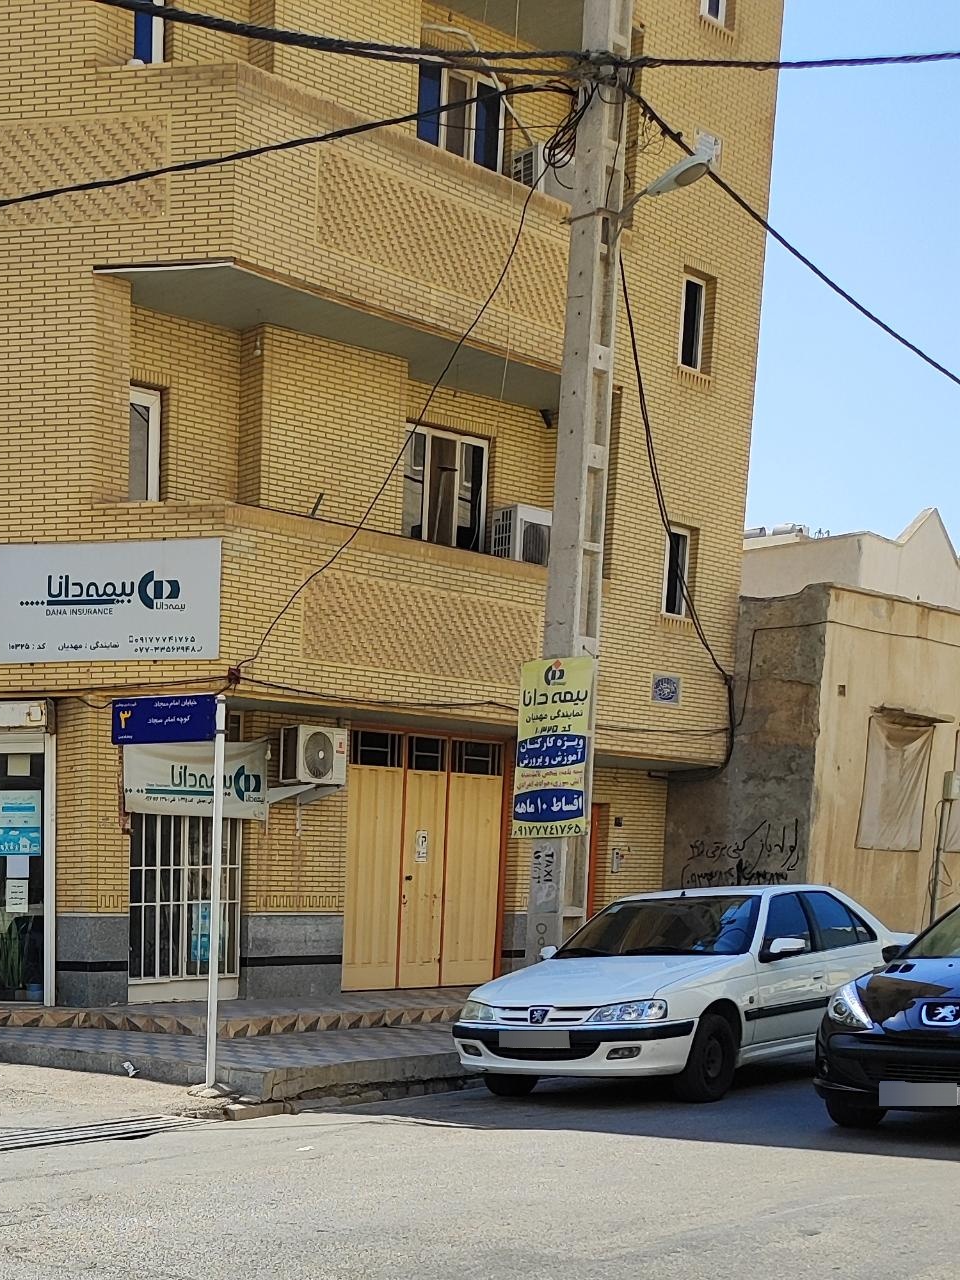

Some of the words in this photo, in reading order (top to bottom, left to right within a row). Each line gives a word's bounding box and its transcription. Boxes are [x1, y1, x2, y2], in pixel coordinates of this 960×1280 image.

[47, 574, 83, 598] دانا
[70, 607, 113, 616] INSURANCE
[523, 688, 548, 706] دانا
[552, 690, 588, 705] بیمه
[120, 710, 131, 729] ۳
[147, 717, 163, 725] سجاد
[177, 715, 191, 725] کوچه
[550, 709, 584, 720] نمایندگی
[520, 736, 555, 752] کارکنان
[557, 736, 584, 749] ویژه
[519, 754, 543, 767] پرورش
[544, 756, 550, 766] و
[551, 749, 583, 764] آموزش
[171, 764, 197, 788] دانا
[515, 798, 535, 813] ماهه
[537, 797, 548, 814] ۱۰
[551, 794, 583, 811] اقساط
[543, 852, 554, 882] TAXI
